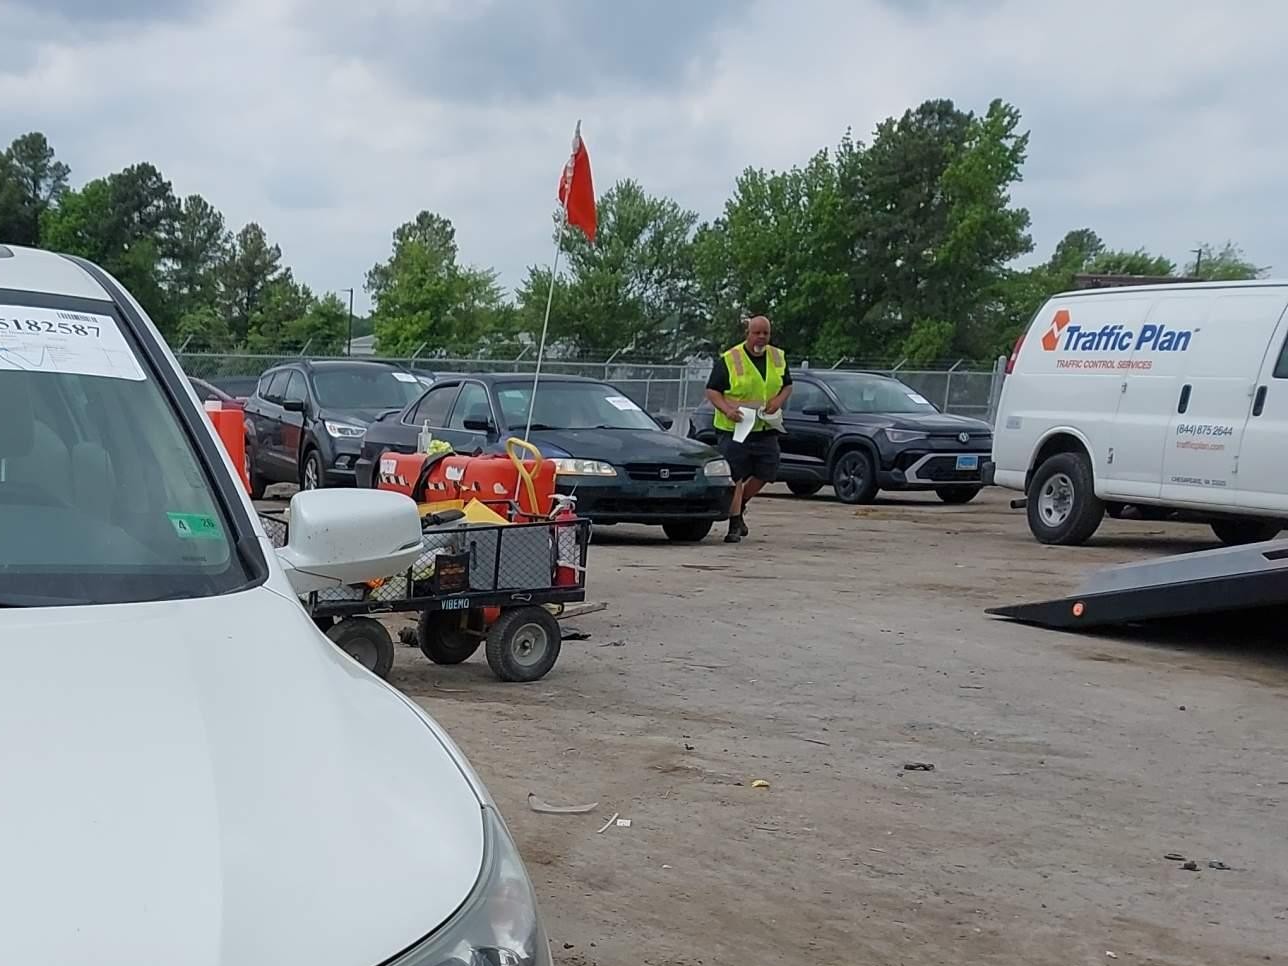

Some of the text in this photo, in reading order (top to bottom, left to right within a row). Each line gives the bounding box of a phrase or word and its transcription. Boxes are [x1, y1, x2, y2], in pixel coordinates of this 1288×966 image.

[1064, 324, 1192, 351] Traffic Plan
[1056, 359, 1152, 370] TRAFFIC CONTROL SERVICES
[178, 519, 187, 531] 4
[441, 598, 470, 610] VIBEMO
